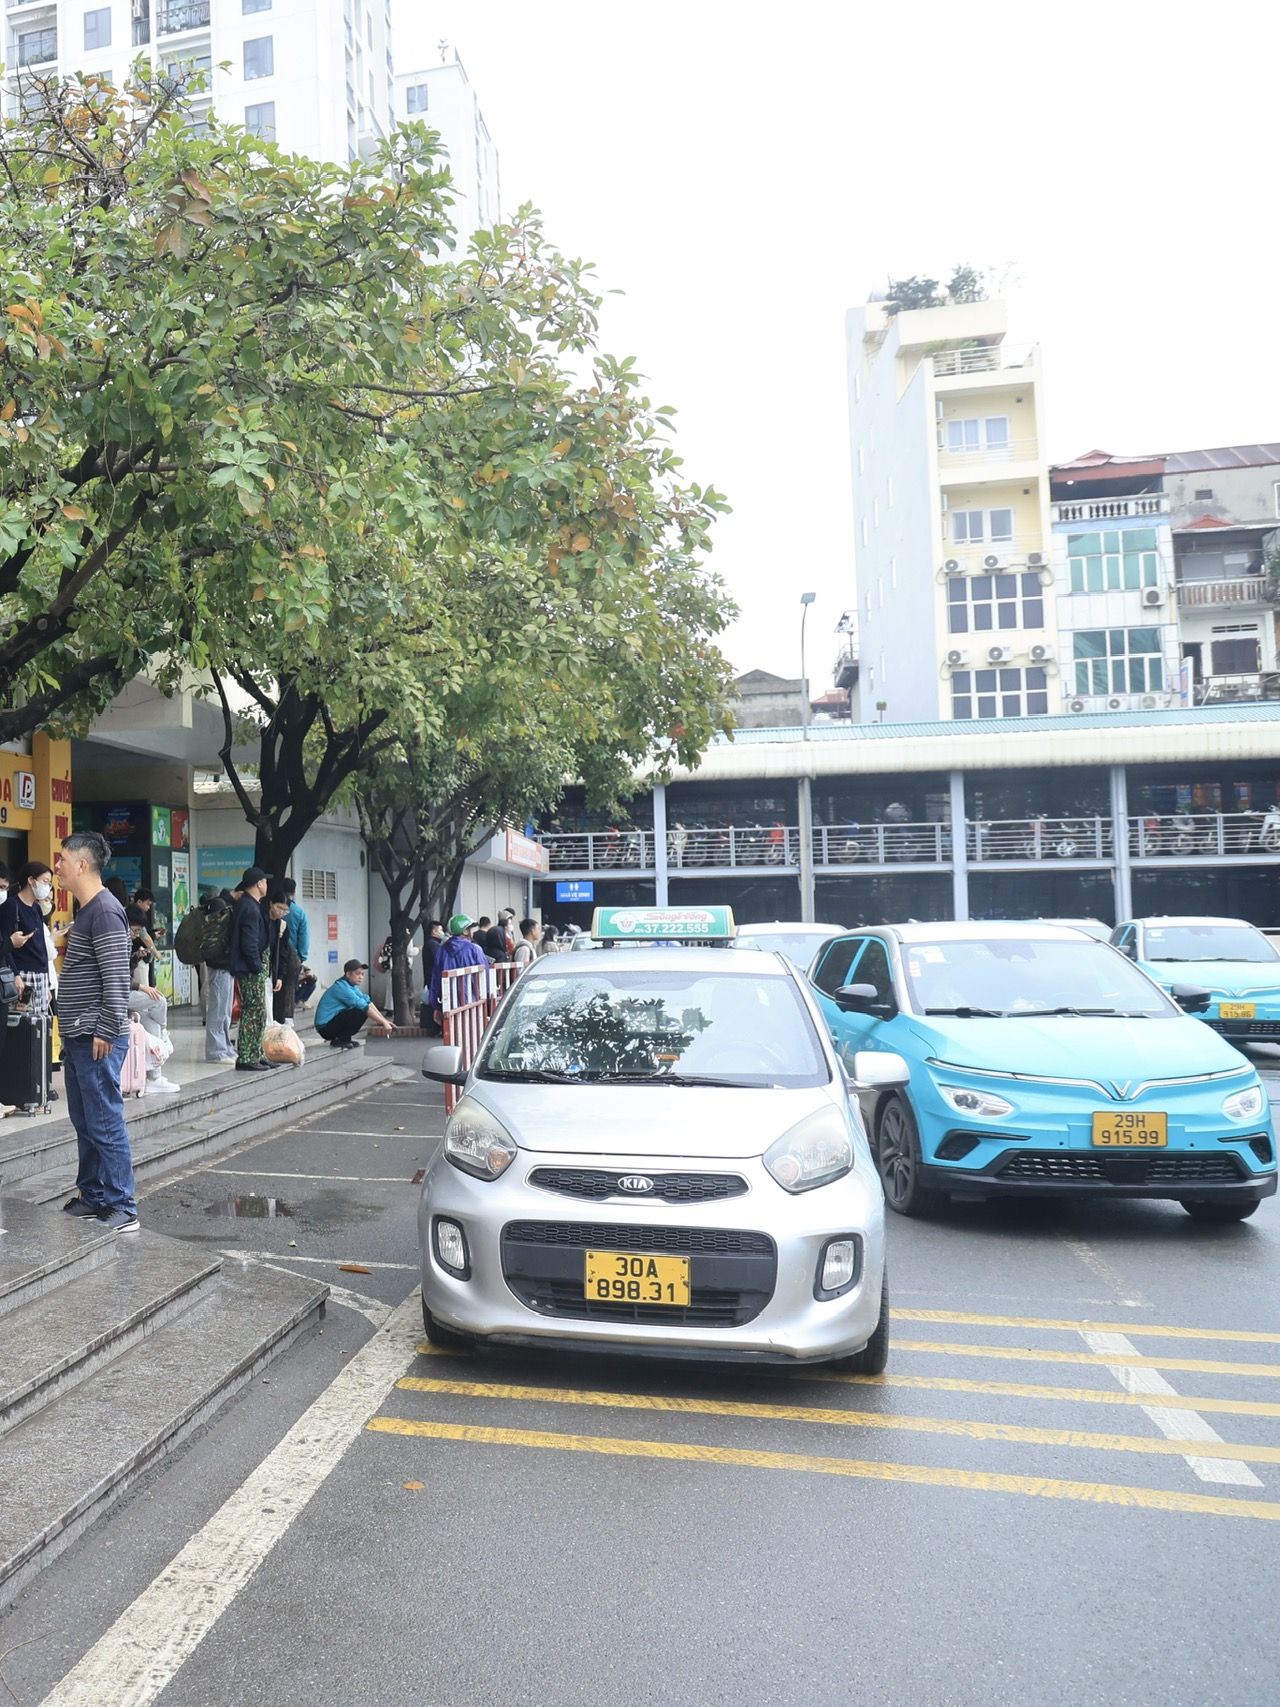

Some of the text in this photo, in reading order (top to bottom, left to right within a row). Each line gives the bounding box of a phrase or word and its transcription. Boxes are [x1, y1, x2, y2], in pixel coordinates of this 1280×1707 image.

[645, 923, 709, 934] 37.222.555
[1114, 1114, 1146, 1128] 29H
[1101, 1129, 1159, 1144] 915.99
[623, 1178, 648, 1189] KIA
[615, 1256, 658, 1278] 30A
[597, 1278, 675, 1302] 898.31
